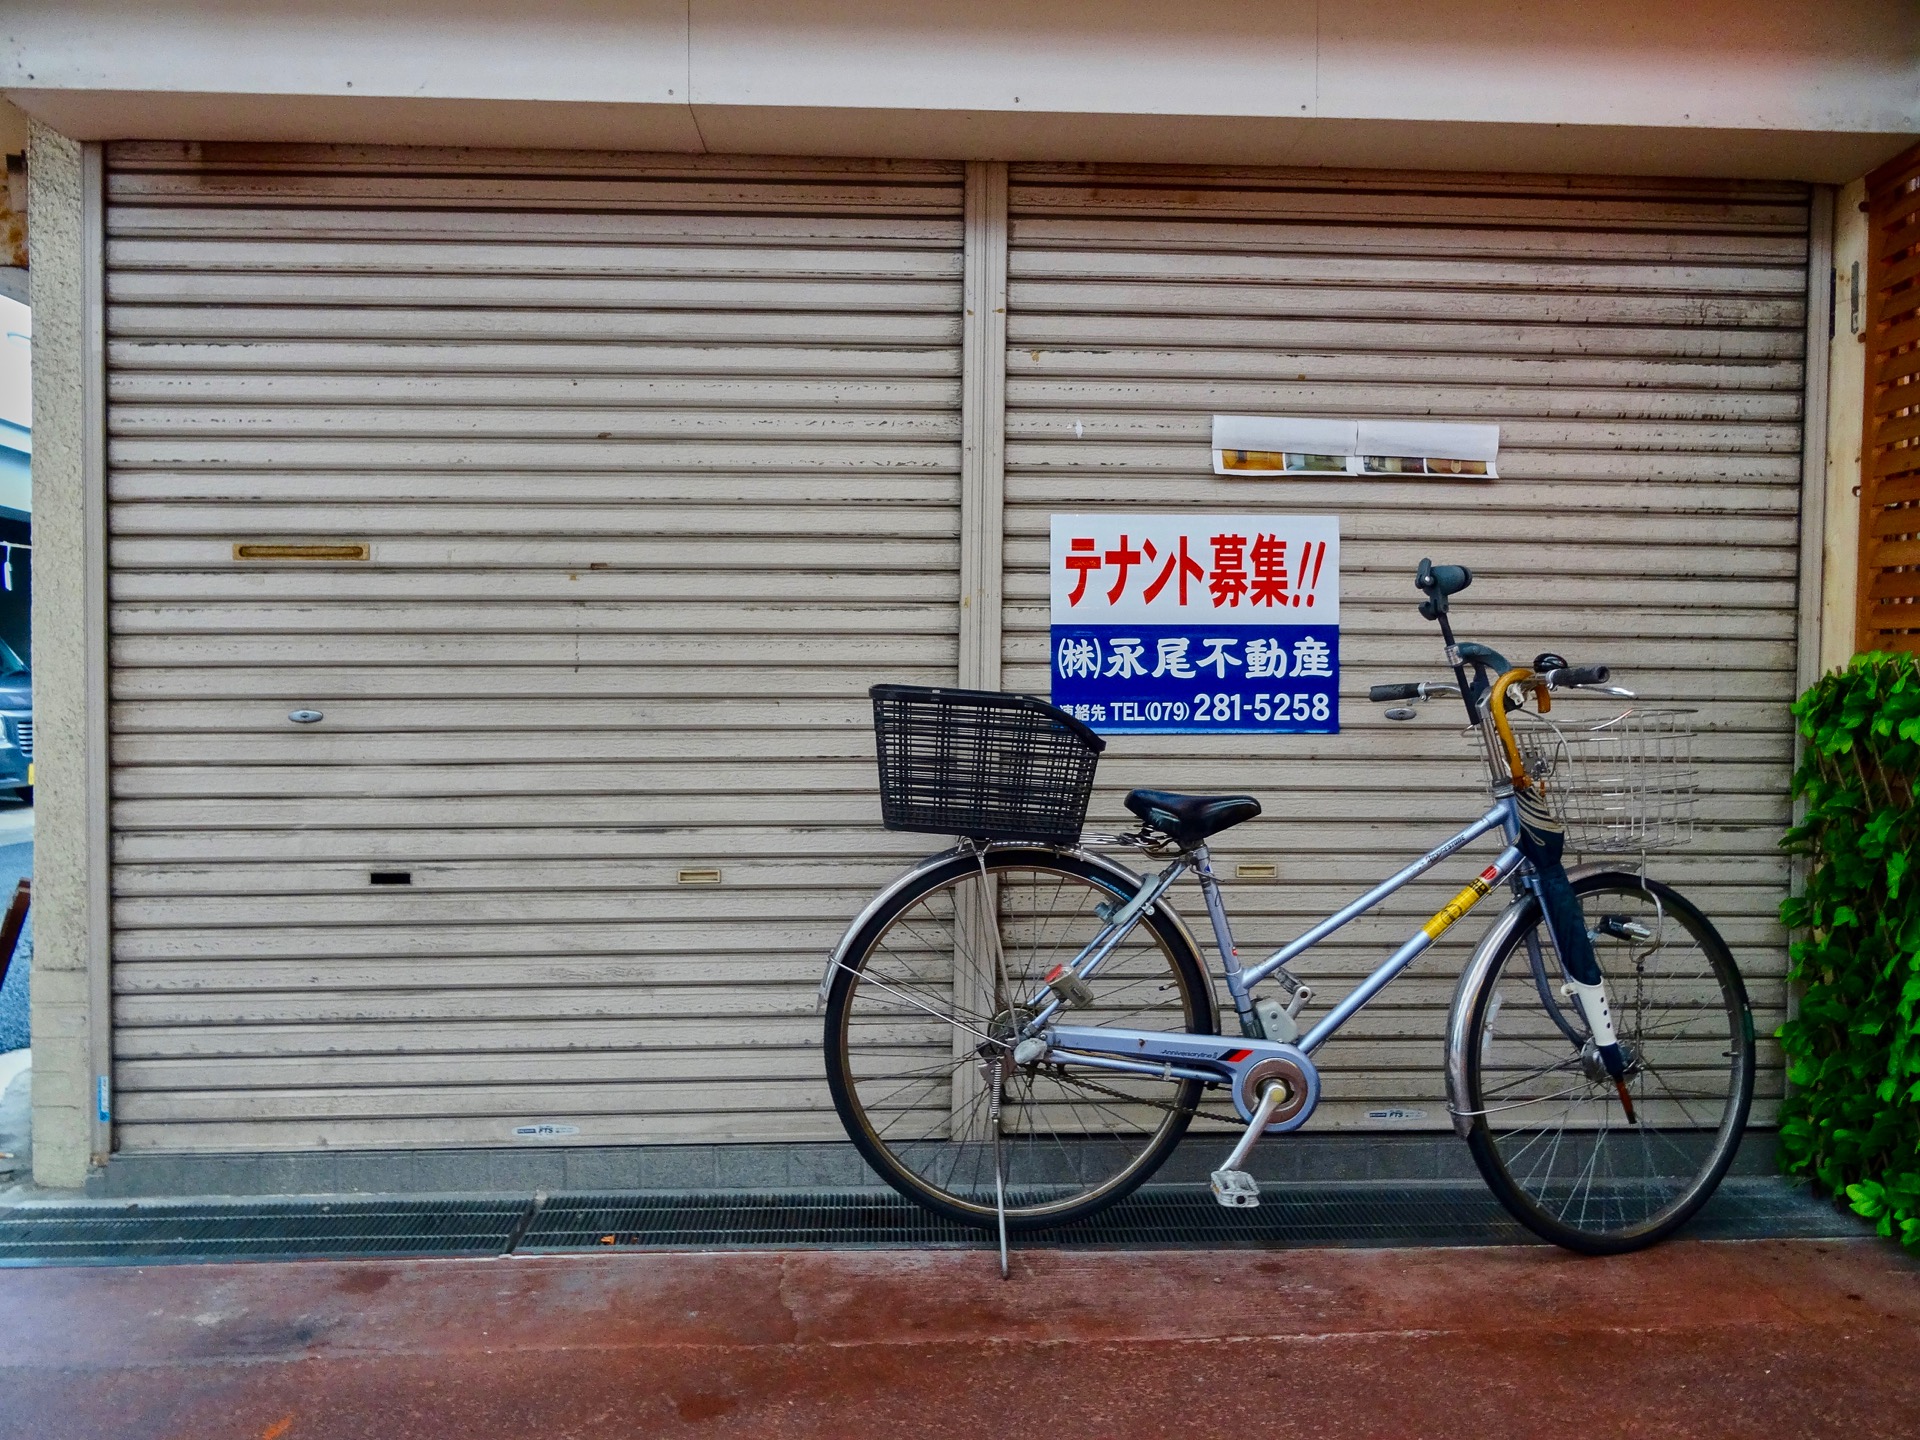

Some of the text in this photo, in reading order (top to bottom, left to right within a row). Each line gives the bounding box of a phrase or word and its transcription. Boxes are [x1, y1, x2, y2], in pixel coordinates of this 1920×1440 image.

[1065, 533, 1327, 608] テナント募集!!
[1058, 636, 1333, 679] (株)永尾不動産
[1110, 702, 1190, 721] TEL(079)
[1193, 693, 1330, 722] 281-5258
